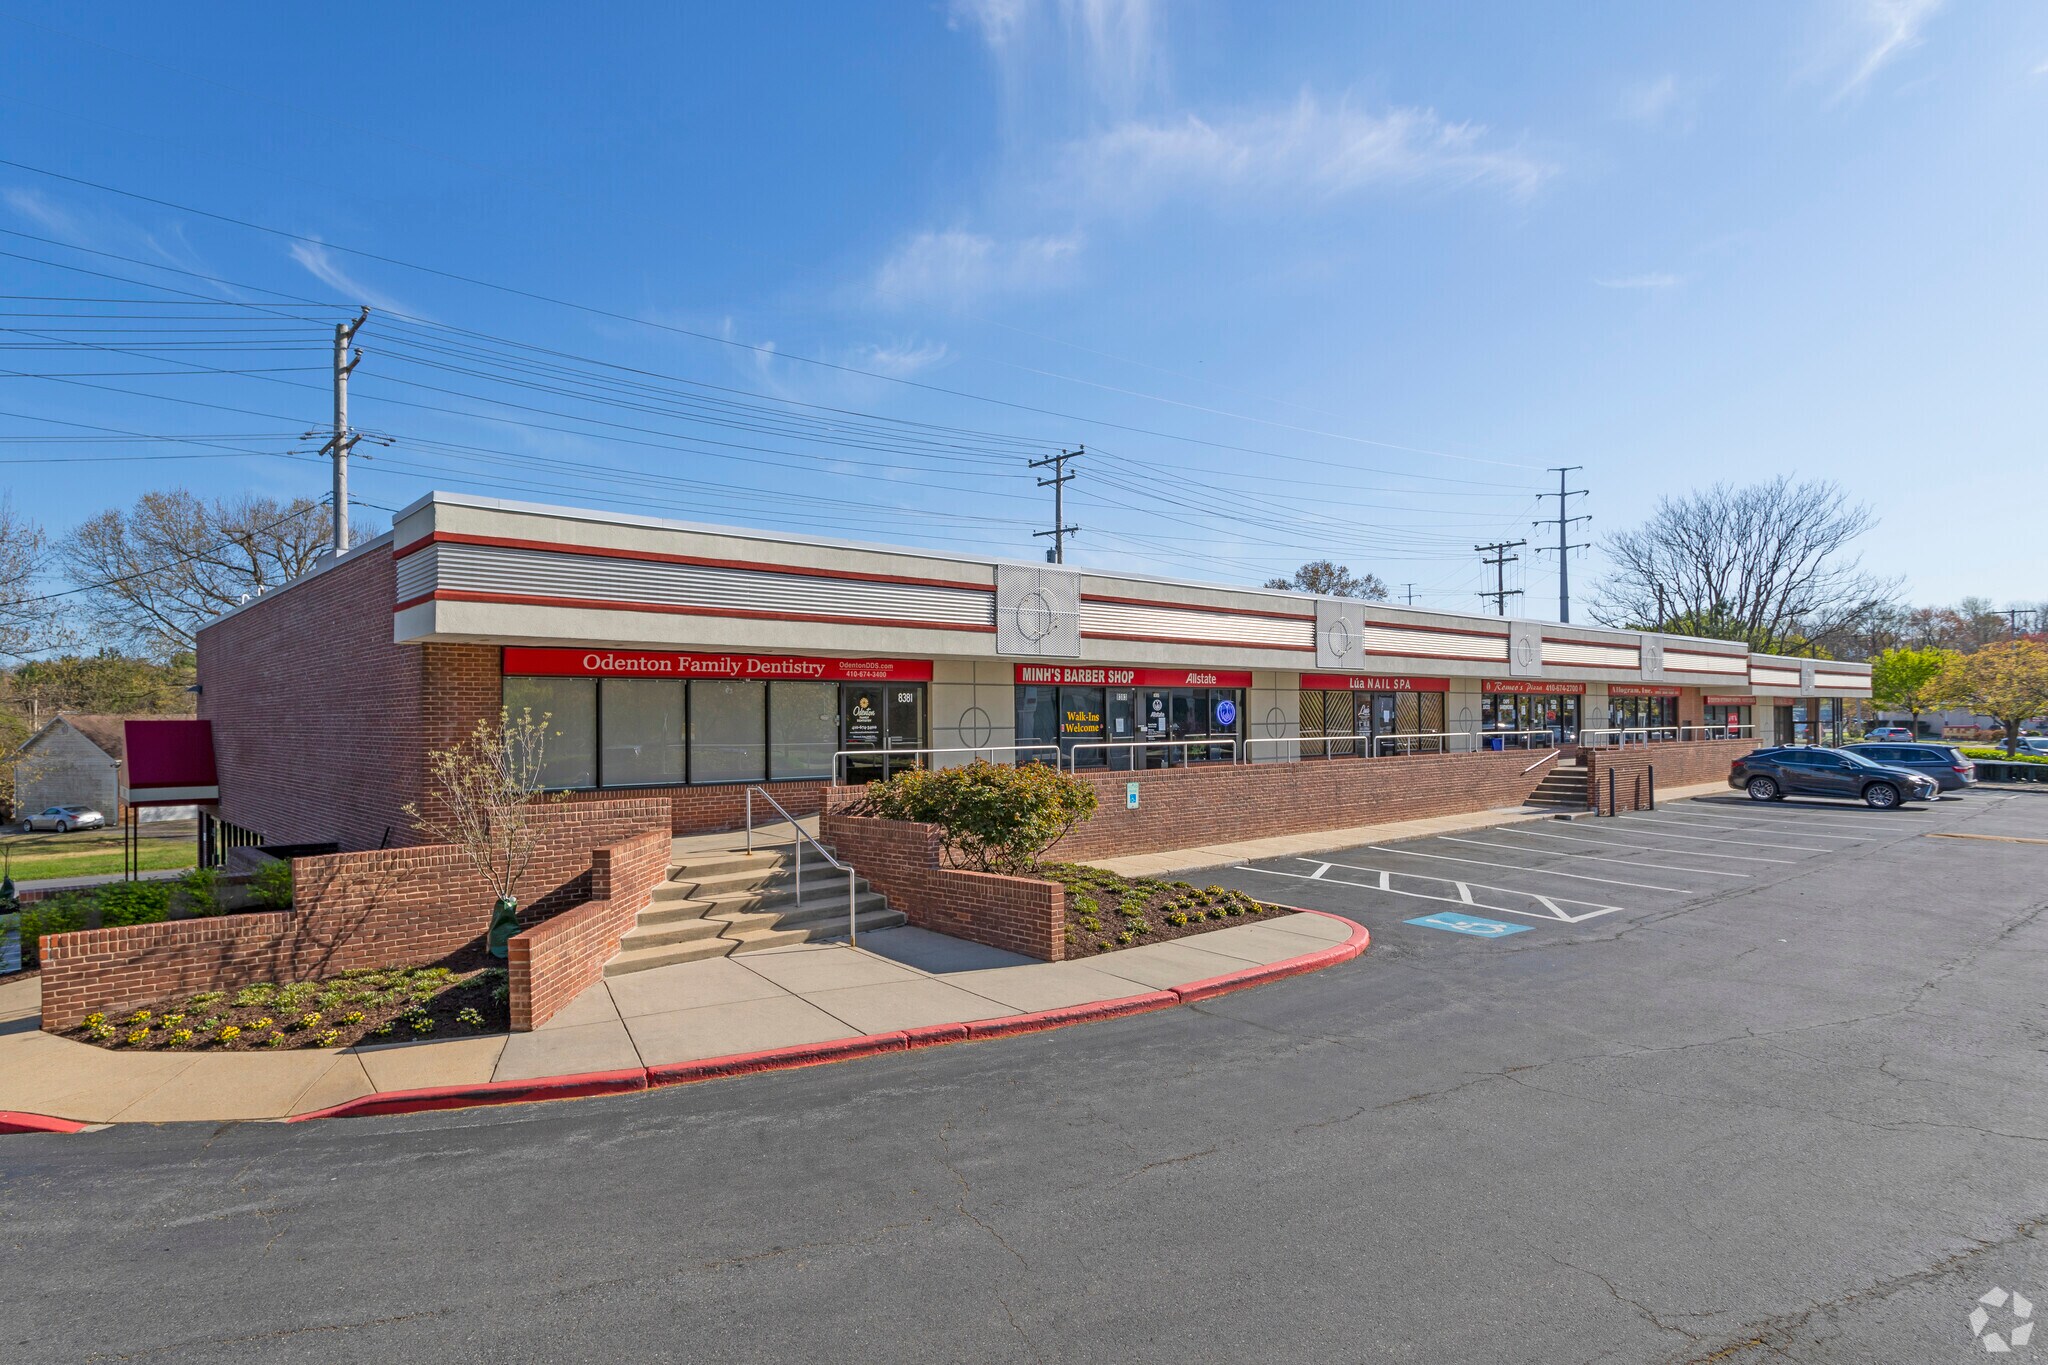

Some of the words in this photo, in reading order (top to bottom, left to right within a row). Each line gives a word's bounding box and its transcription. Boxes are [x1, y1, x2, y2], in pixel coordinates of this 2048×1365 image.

[583, 654, 672, 671] Odenton
[678, 657, 741, 676] Family
[747, 659, 826, 677] Dentistry
[1022, 667, 1061, 681] MINH'S
[1064, 669, 1105, 683] BARBER
[1108, 670, 1134, 684] SHOP
[1185, 673, 1217, 684] Allstate
[1350, 678, 1364, 688] Lúa
[1367, 678, 1390, 689] NAIL
[1393, 679, 1411, 690] SPA
[1525, 682, 1543, 692] Pizza
[898, 693, 913, 702] 8381
[1066, 711, 1100, 721] Walk-Ins
[1065, 723, 1100, 732] Welcome
